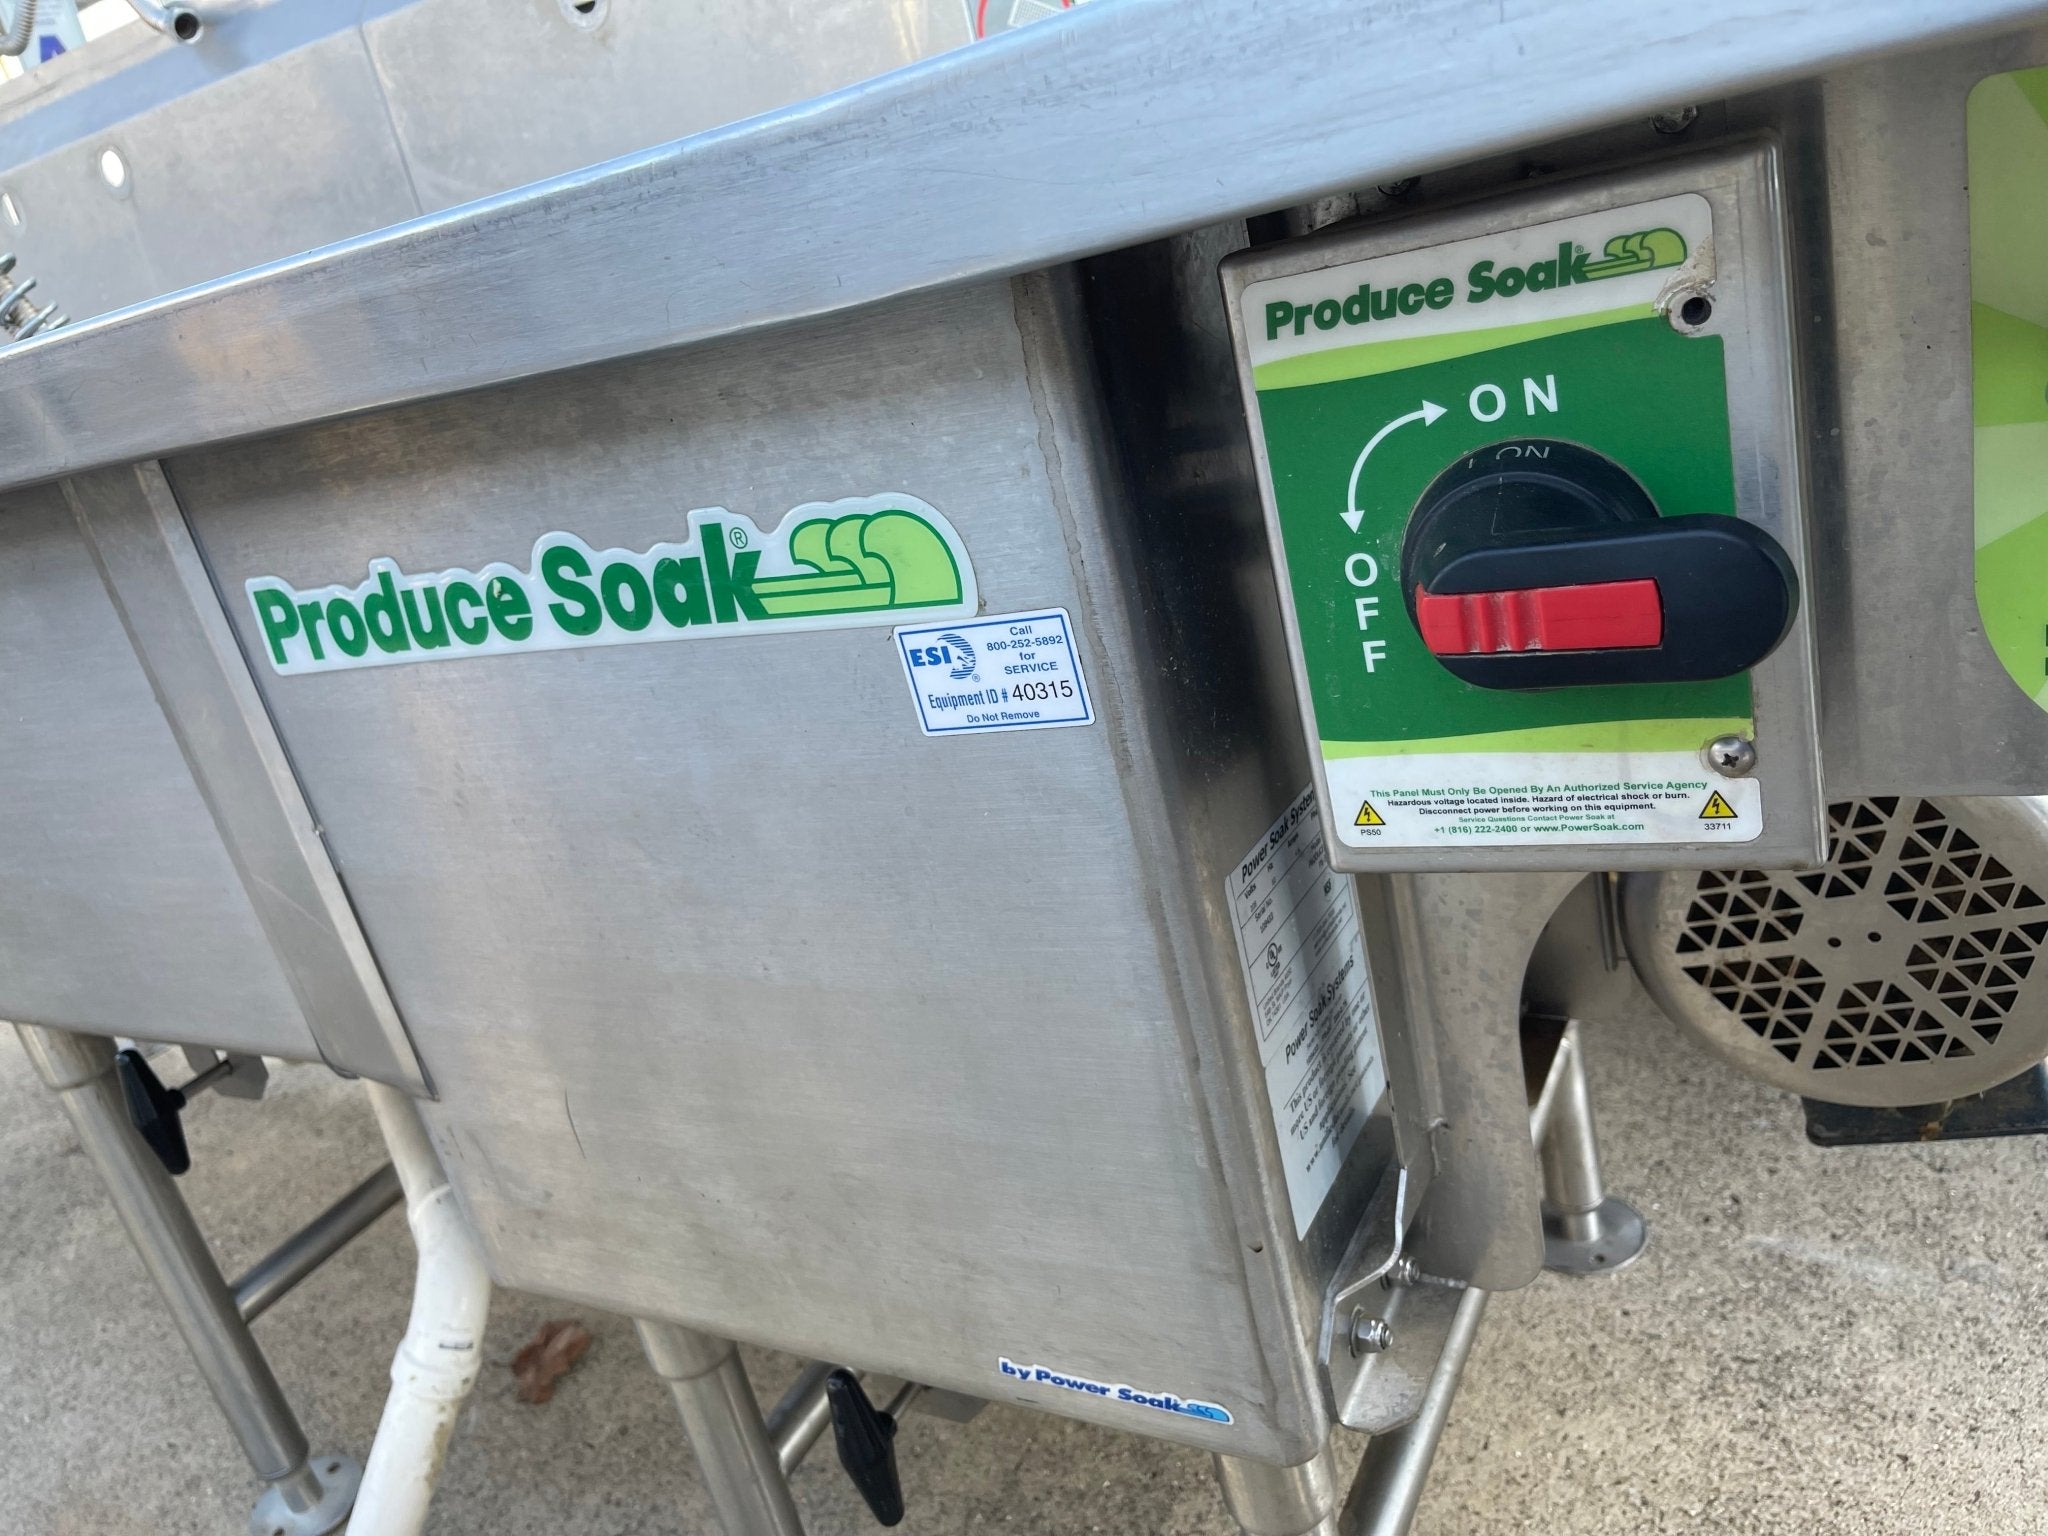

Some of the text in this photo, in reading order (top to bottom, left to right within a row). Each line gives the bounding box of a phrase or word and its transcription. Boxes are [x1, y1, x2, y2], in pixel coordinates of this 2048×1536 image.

[1265, 276, 1455, 341] Produce
[1468, 374, 1559, 422] ON
[252, 572, 533, 665] Produce
[1010, 626, 1032, 636] Call
[986, 635, 1063, 651] 800-252-5892
[909, 645, 952, 668] ESI
[1019, 652, 1036, 661] for
[1004, 661, 1058, 675] SERVICE
[928, 692, 985, 711] Equipment
[986, 689, 999, 705] ID
[1012, 680, 1073, 702] 40315
[967, 711, 1040, 723] Do Not Remove
[1370, 781, 1707, 797] This Panel Must Only Be Opened By An Authorized Service Agency
[1433, 798, 1465, 807] voltage
[1467, 796, 1498, 804] located
[1532, 794, 1563, 803] Hazard
[1566, 794, 1575, 802] of
[1577, 792, 1619, 801] electrical
[1621, 792, 1650, 800] shock
[1652, 792, 1663, 800] or
[1664, 791, 1690, 799] burn.
[1473, 806, 1500, 815] power
[1502, 805, 1530, 813] before
[1532, 803, 1568, 813] working
[1570, 804, 1582, 812] on
[1584, 802, 1601, 811] this
[1603, 801, 1656, 812] equipment.
[1488, 815, 1525, 823] Questions
[1704, 822, 1731, 831] 33711
[1360, 828, 1382, 836] PS50
[1434, 822, 1645, 835] +1 (816) 222-2400 or www.PowerSoak.com
[1242, 843, 1269, 883] Power
[1268, 818, 1289, 850] Soak
[1286, 1021, 1309, 1064] Power
[1308, 995, 1326, 1029] Soak
[1327, 955, 1355, 1003] Systems
[1290, 1090, 1302, 1114] This
[1302, 1061, 1322, 1098] product
[1001, 1361, 1180, 1411] by Power Soak
